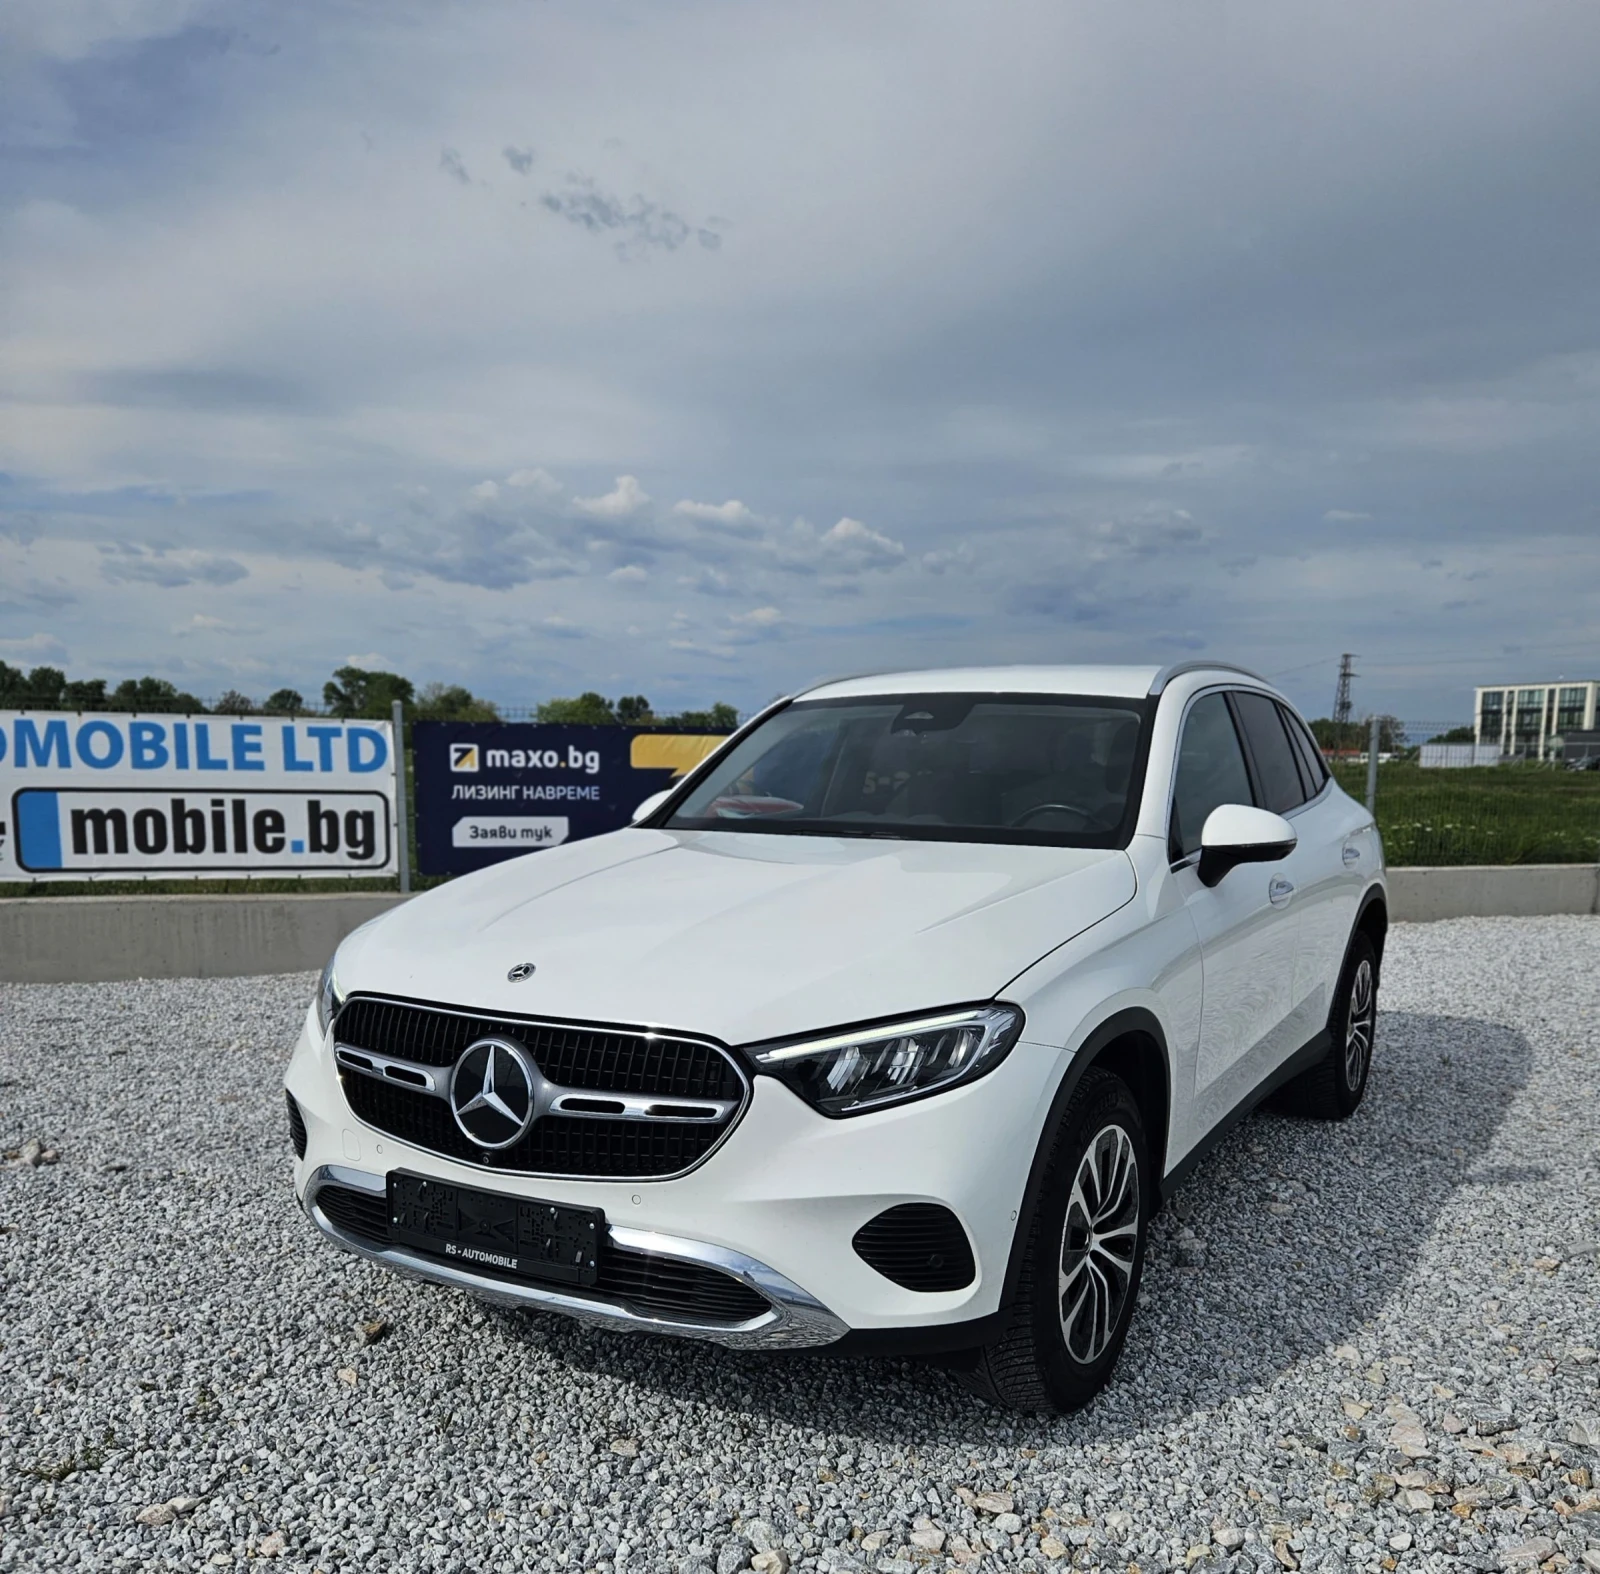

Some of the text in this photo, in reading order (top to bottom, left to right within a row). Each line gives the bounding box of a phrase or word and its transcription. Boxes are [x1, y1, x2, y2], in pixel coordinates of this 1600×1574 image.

[0, 718, 388, 773] MOBILE LTD
[486, 744, 600, 774] maxo.bg
[451, 784, 600, 801] ЛИЗИНГ НАВРЕМЕ
[70, 797, 376, 860] mobile.bg
[468, 825, 553, 842] Заяви тук
[445, 1243, 457, 1255] RS
[461, 1248, 518, 1269] AUTOMOBILE
